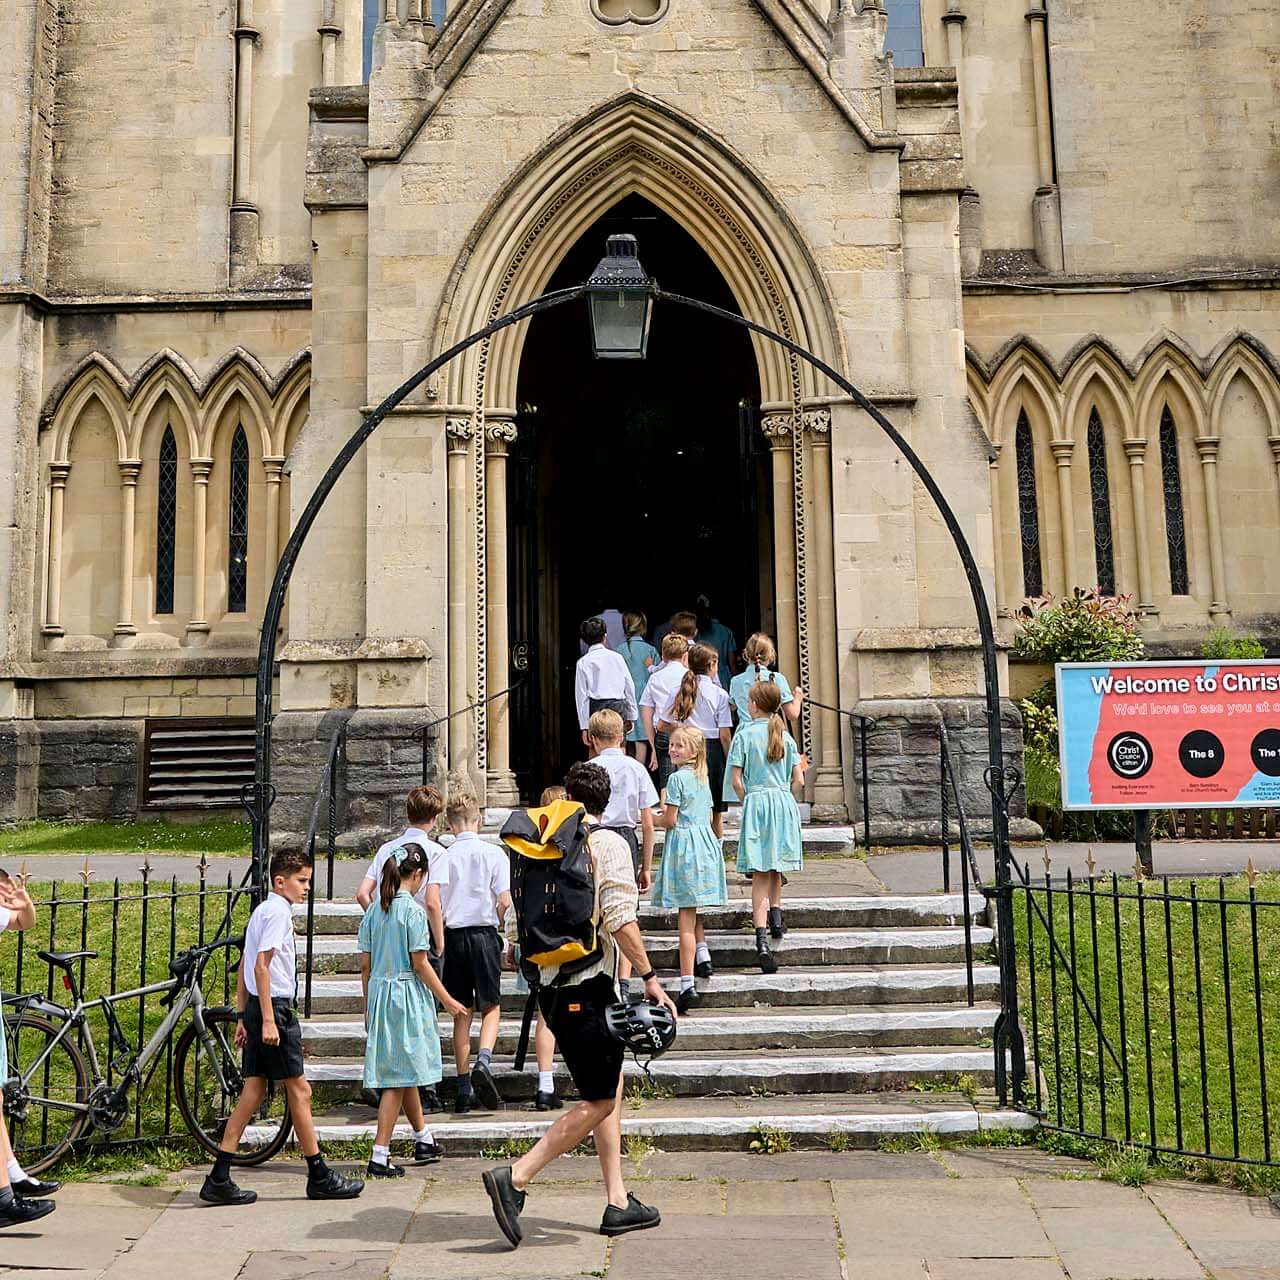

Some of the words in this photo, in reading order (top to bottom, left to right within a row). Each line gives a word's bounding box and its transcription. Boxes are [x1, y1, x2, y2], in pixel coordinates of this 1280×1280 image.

[1091, 675, 1190, 694] Welcome
[1195, 677, 1217, 693] to
[1113, 703, 1148, 715] We'd
[1151, 703, 1179, 714] love
[1183, 703, 1197, 714] to
[1200, 704, 1223, 713] see
[1227, 704, 1252, 716] you
[1256, 701, 1270, 713] at
[1118, 746, 1140, 754] Christ
[1189, 750, 1206, 759] The
[1207, 749, 1215, 758] 8
[1258, 748, 1276, 757] The
